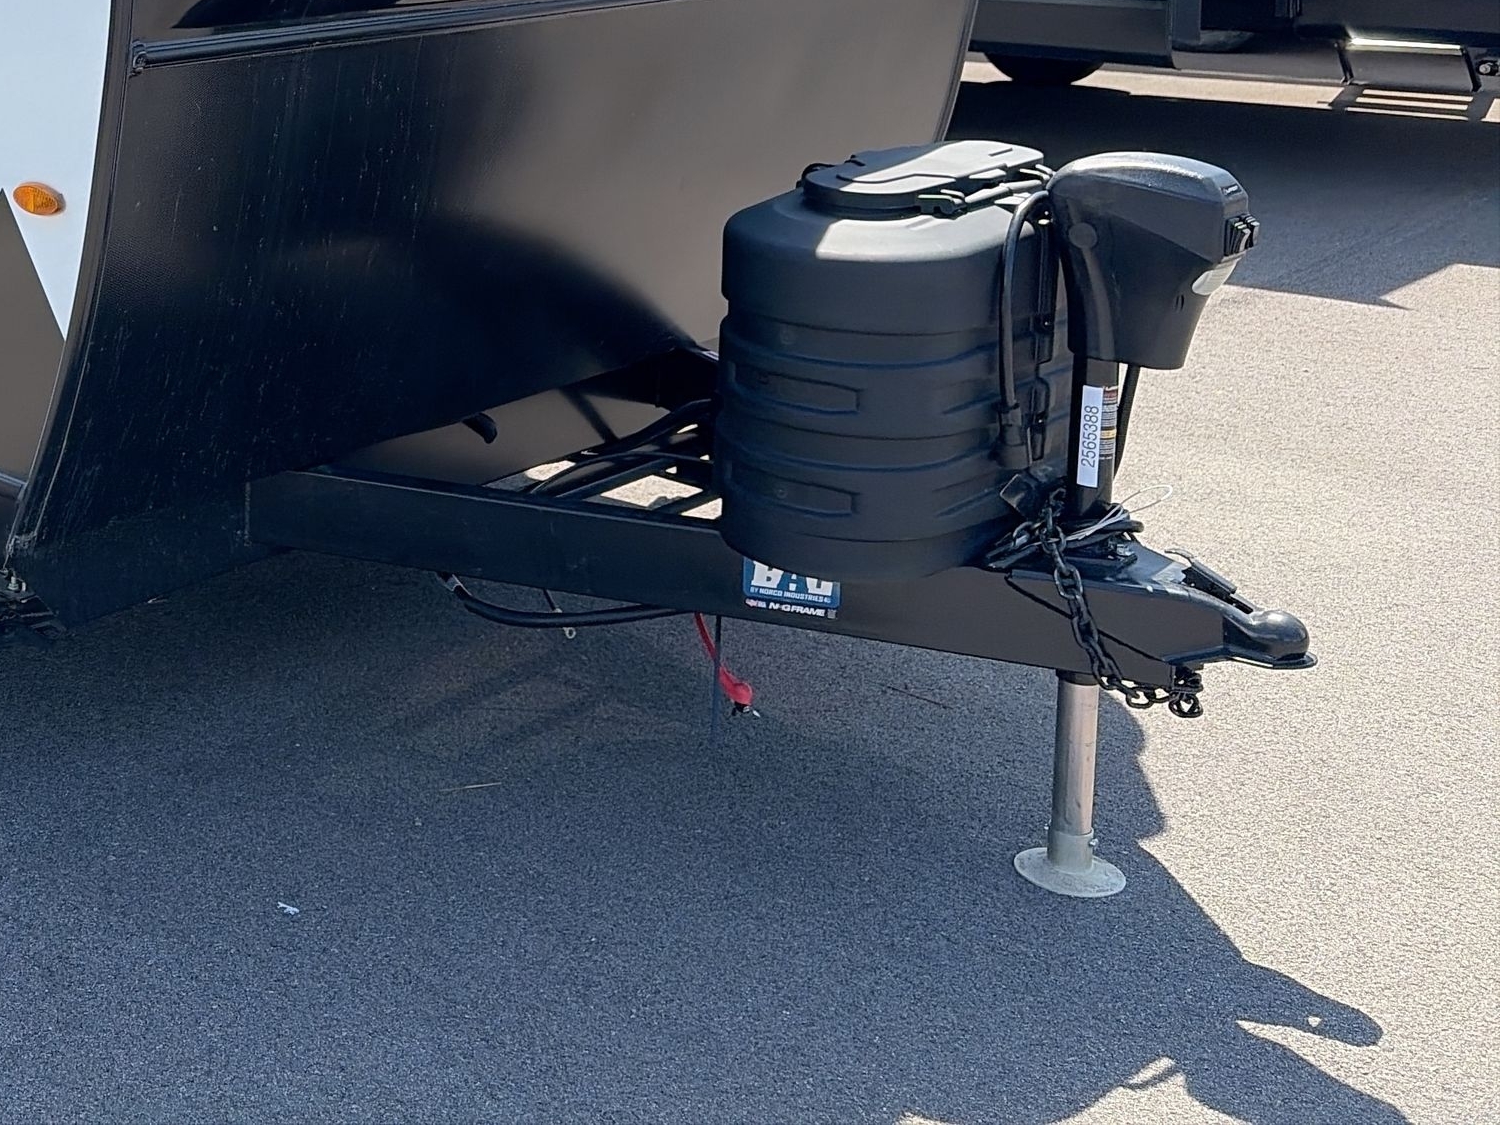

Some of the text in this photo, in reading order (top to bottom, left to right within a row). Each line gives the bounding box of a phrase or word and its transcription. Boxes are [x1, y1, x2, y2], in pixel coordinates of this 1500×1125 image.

[1080, 405, 1099, 468] 2565388
[759, 588, 783, 597] NORCO
[783, 591, 824, 603] INDUSTRIES
[768, 602, 790, 612] NG
[790, 605, 825, 617] FRAME
